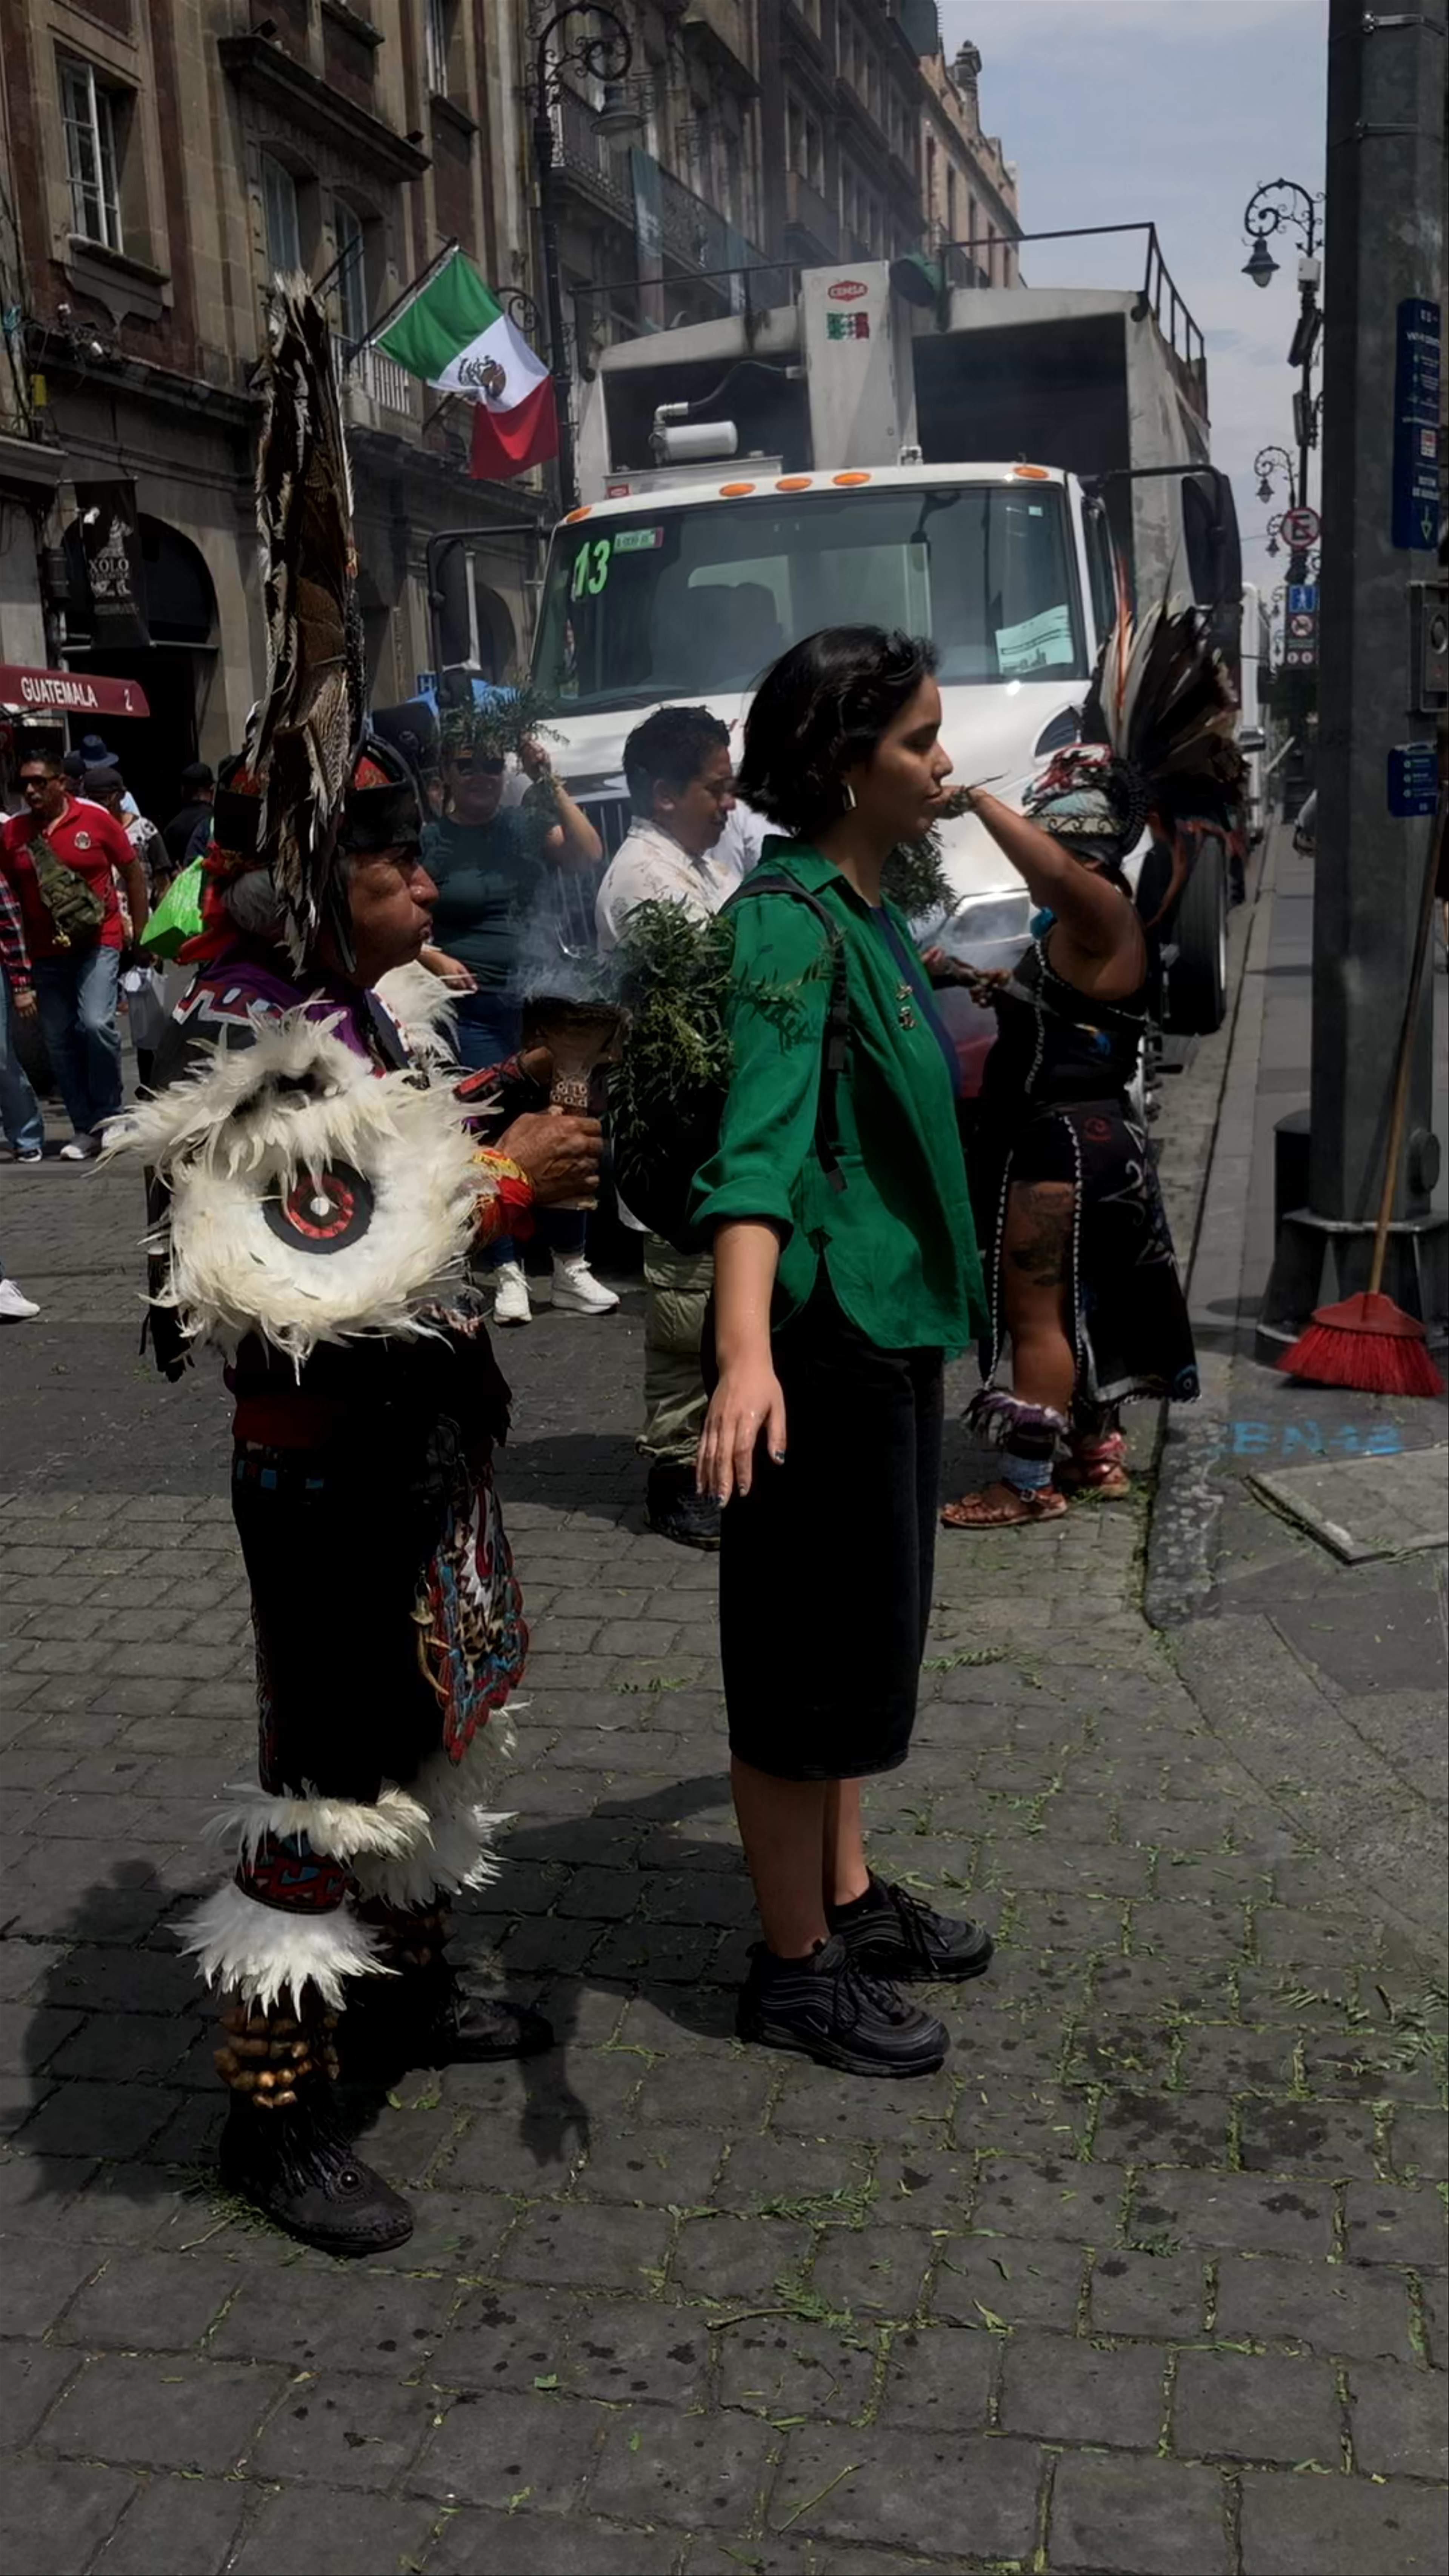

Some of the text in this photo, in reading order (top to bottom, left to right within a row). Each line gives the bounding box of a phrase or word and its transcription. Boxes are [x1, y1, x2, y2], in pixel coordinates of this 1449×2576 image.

[88, 558, 129, 574] XOLO
[572, 540, 610, 597] 13
[21, 676, 133, 711] GUATEMALA 2
